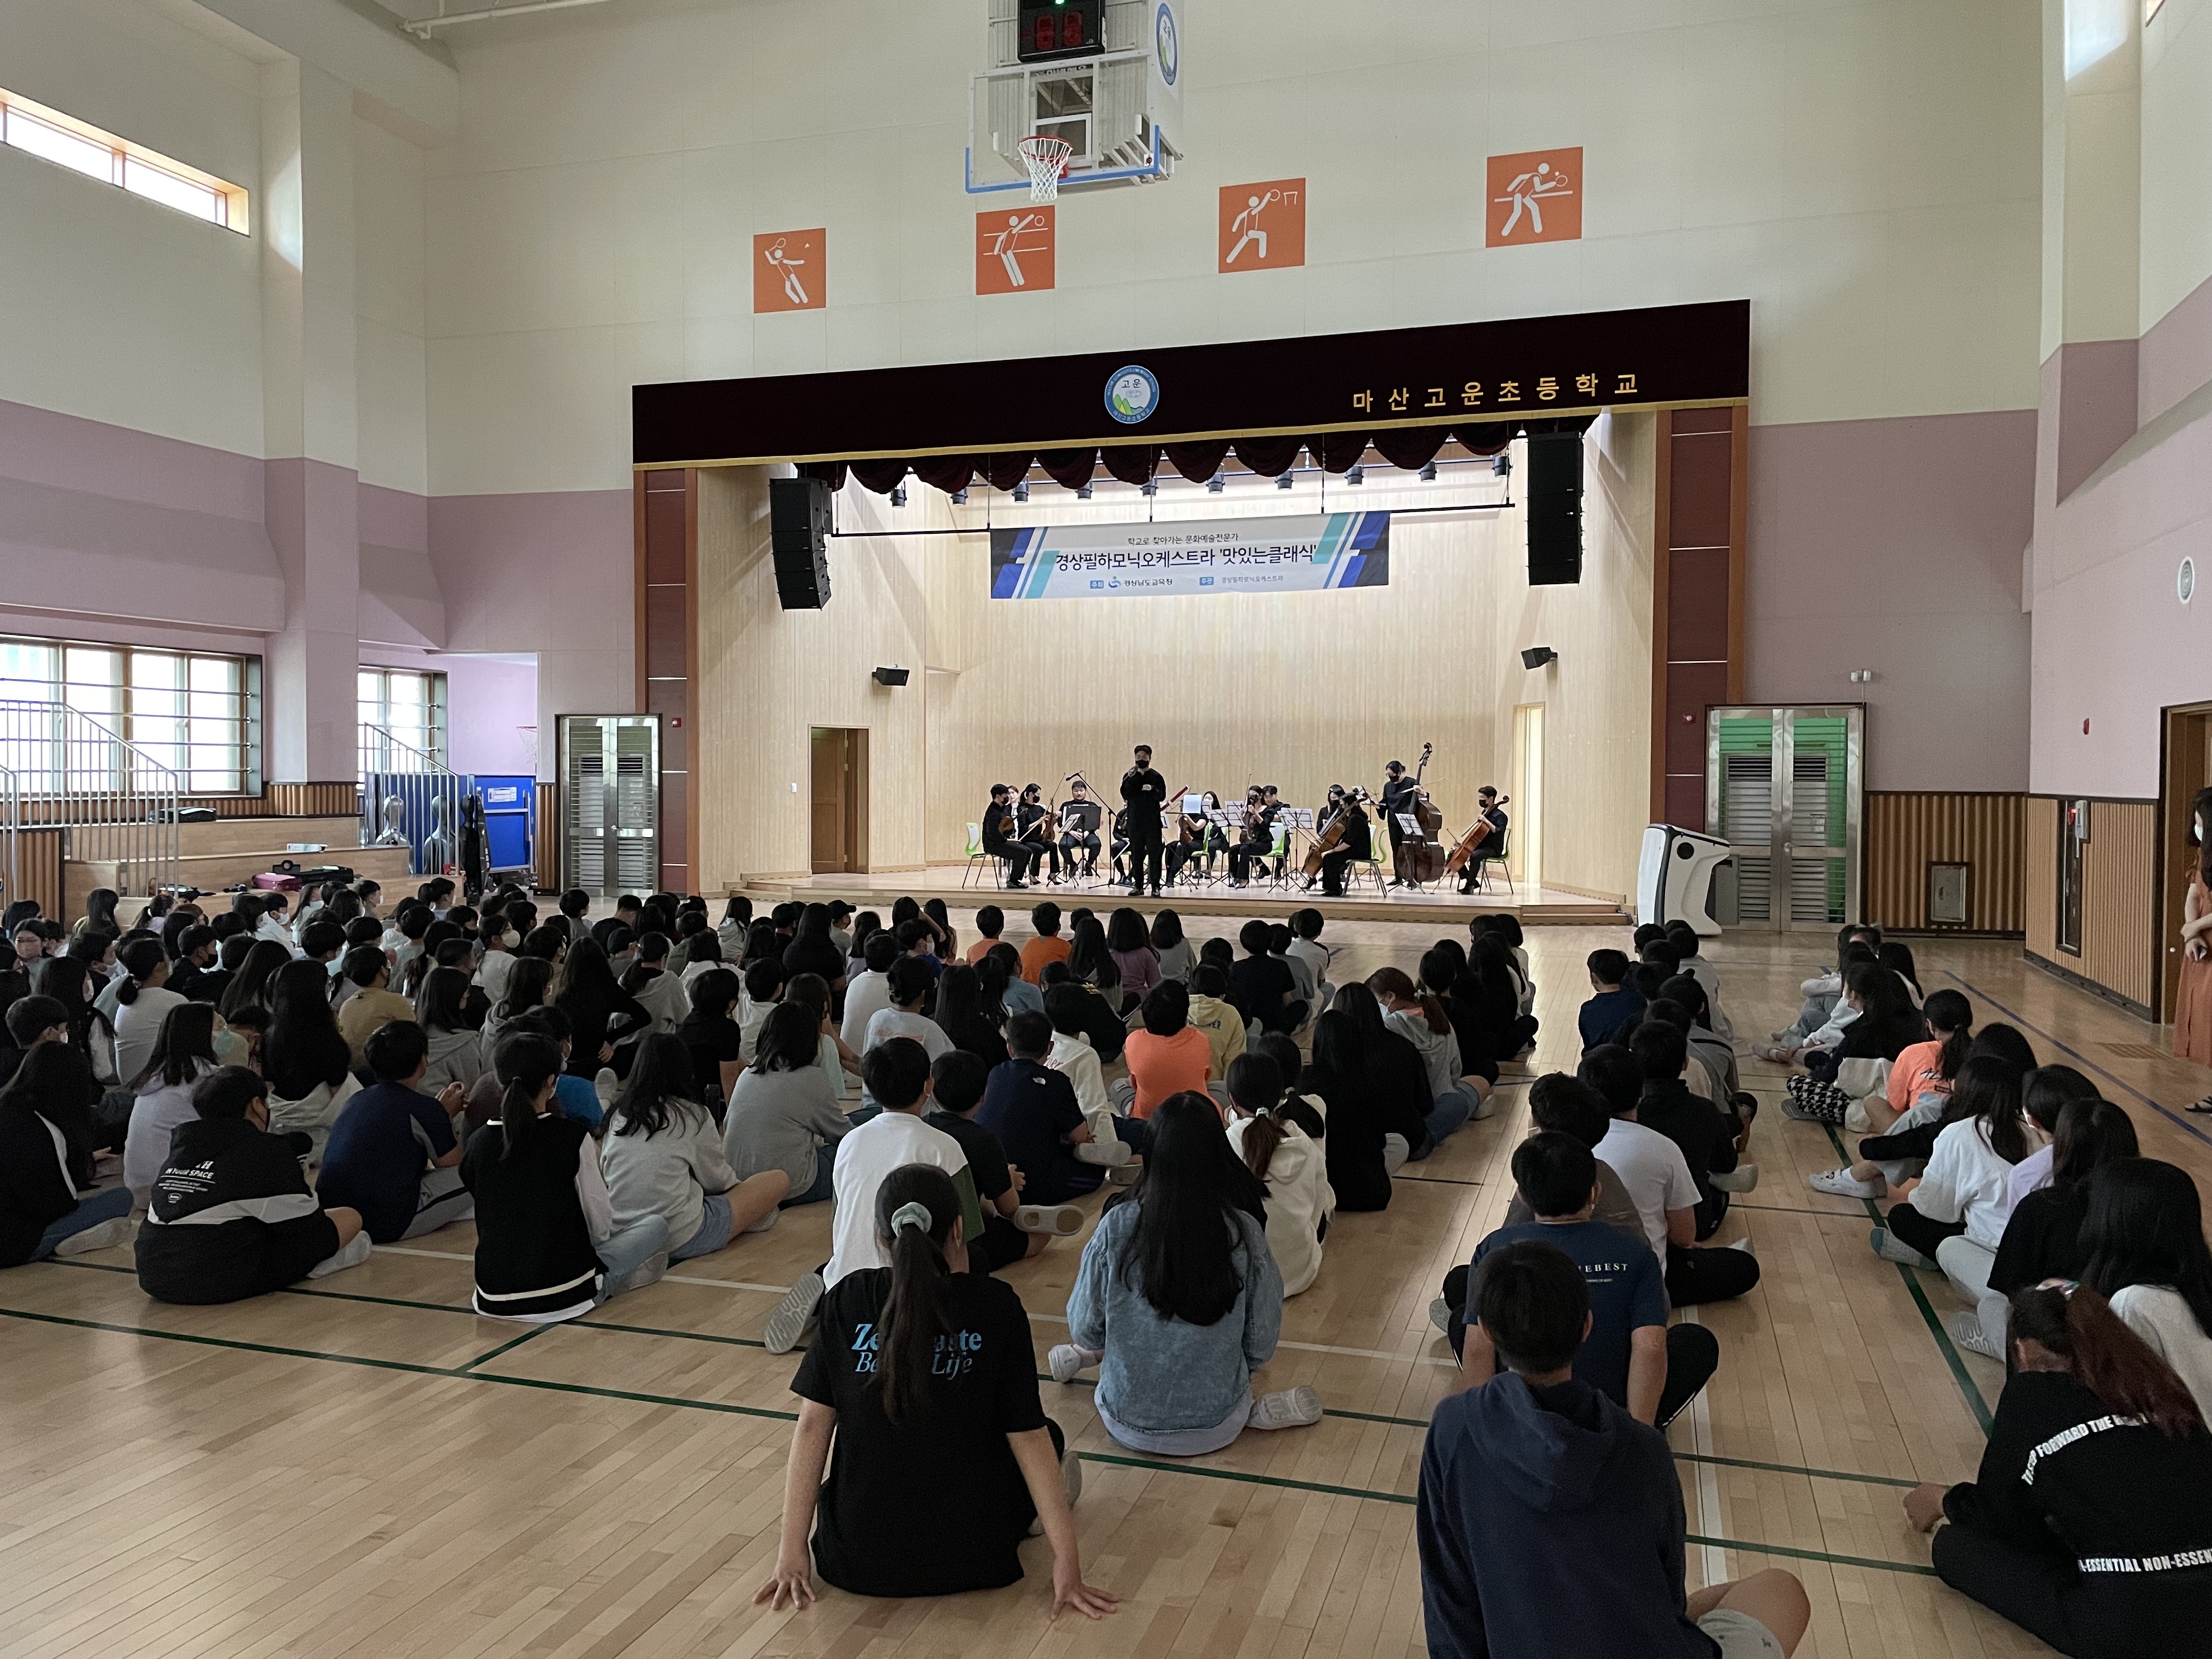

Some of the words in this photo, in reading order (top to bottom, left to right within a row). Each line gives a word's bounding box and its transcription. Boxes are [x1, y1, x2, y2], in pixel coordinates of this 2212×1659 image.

[1121, 379, 1141, 388] 고운
[1353, 373, 1638, 412] 마산고운초등학교
[1128, 537, 1150, 546] 학교로
[1153, 535, 1183, 545] 찾아가는
[1186, 533, 1239, 544] 문화예술전문가
[1056, 550, 1215, 571] 경상필하모닉오케스트라
[1220, 544, 1316, 564] '맛있는클래식'
[1222, 575, 1283, 584] 경상필하모닉오케스트라
[189, 1170, 214, 1179] SPACE
[932, 1353, 973, 1380] Life
[2035, 1423, 2089, 1457] FORWARD
